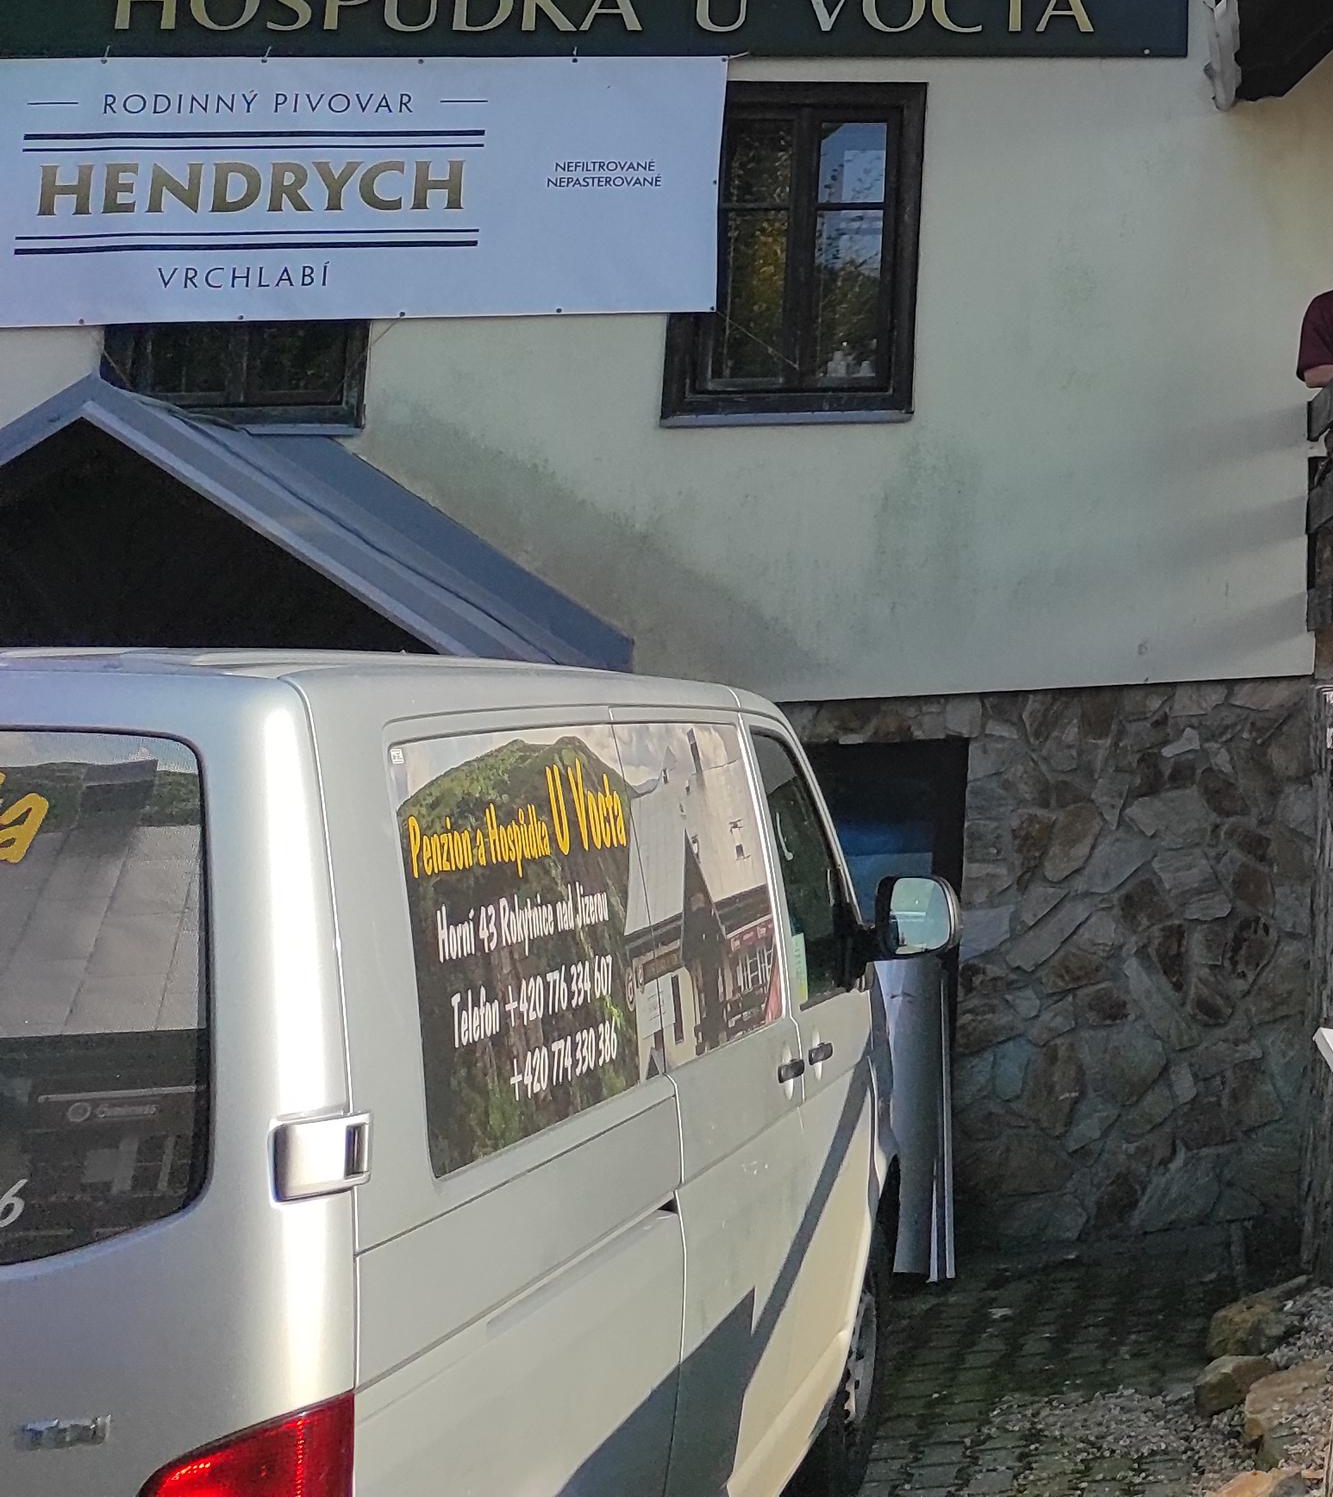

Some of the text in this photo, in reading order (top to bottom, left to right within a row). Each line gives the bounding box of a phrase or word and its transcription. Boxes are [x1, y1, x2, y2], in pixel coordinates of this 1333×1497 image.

[102, 90, 415, 115] RODINNÝ PIVOVAR
[37, 159, 466, 217] HENDRYCH
[546, 173, 662, 188] NEPASTEROVANÉ
[554, 158, 656, 173] NEFILTROVANÉ
[158, 260, 331, 290] VRCHLABÍ
[408, 757, 627, 879] Penzion a Hospůdka U Vocta
[436, 881, 610, 964] Horní 43 Rokytnice nad Jizerou
[451, 985, 501, 1049] Telefon
[505, 975, 544, 1027] +420
[546, 964, 568, 1016] 776
[570, 960, 592, 1008] 334
[594, 955, 613, 1000] 607
[510, 1016, 618, 1101] +420 774 330 386
